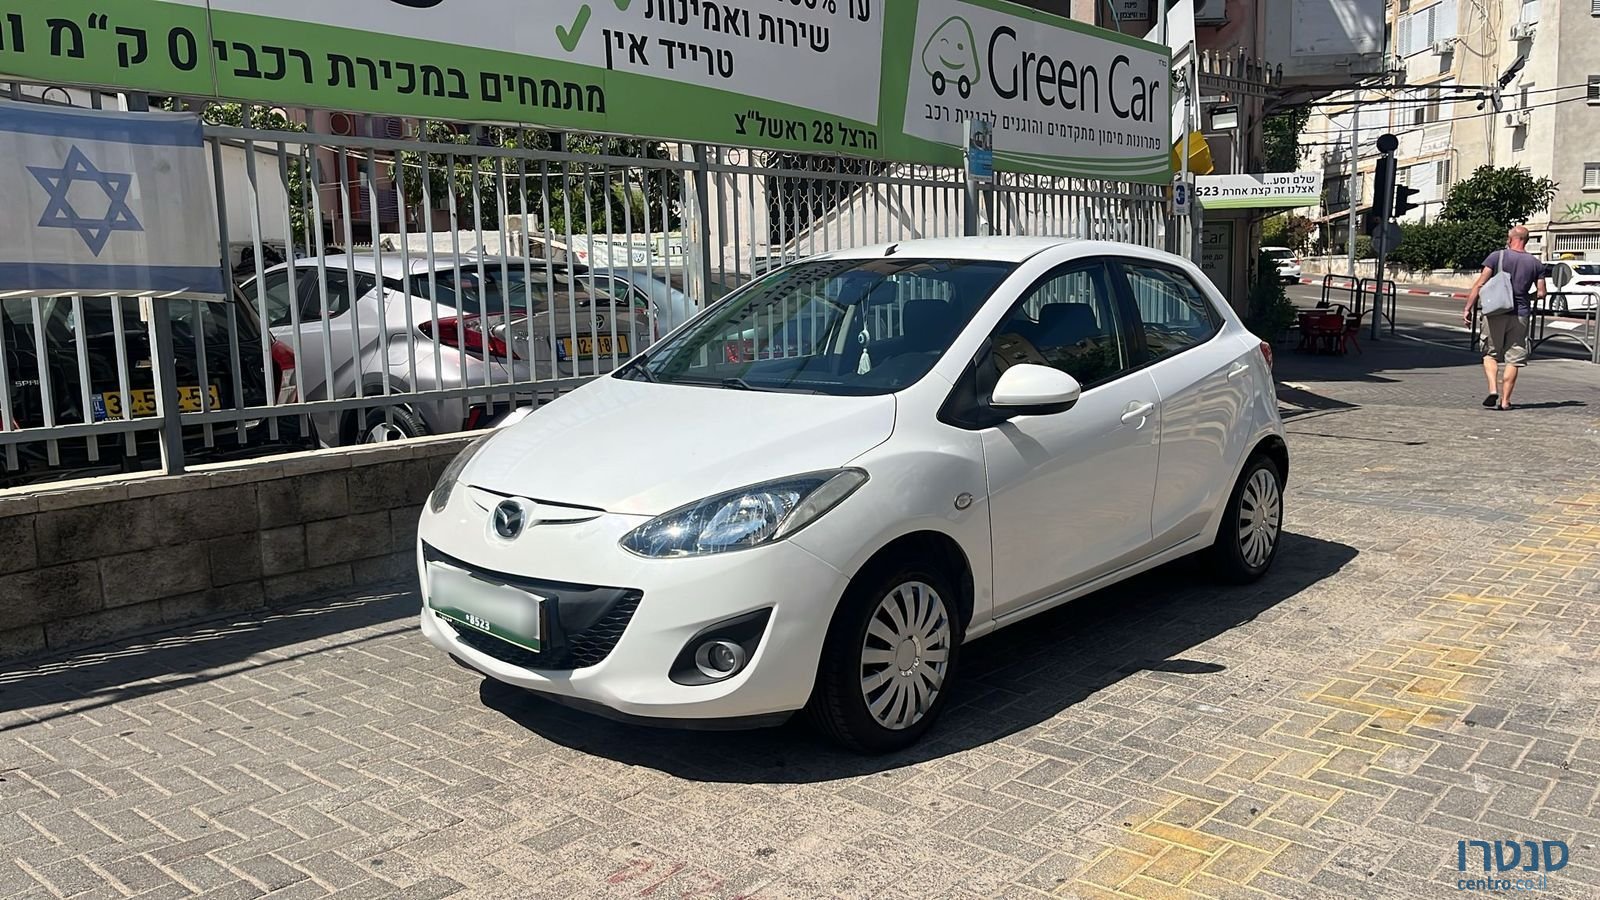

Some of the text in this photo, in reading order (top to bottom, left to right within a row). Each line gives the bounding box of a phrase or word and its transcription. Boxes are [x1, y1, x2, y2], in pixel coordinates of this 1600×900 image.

[644, 0, 829, 52] שירות ואמינות
[602, 29, 734, 78] טרייד אין
[0, 12, 606, 114] מתמחים במכירת רכבי 0 ק"מ ו
[988, 25, 1160, 123] Green Car
[925, 103, 950, 122] רכב
[734, 109, 878, 150] הרצל 28 ראשל"צ
[1002, 115, 1043, 135] והוגנים
[1047, 122, 1095, 144] מתקדמים
[1098, 129, 1123, 147] מימון
[1126, 133, 1161, 150] פתרונות
[1263, 175, 1315, 185] שלם וסע...
[1222, 187, 1249, 196] אחרת
[1250, 187, 1271, 197] קצת
[1274, 186, 1285, 194] זה
[1287, 185, 1315, 194] אצלנו
[1201, 230, 1225, 244] Car
